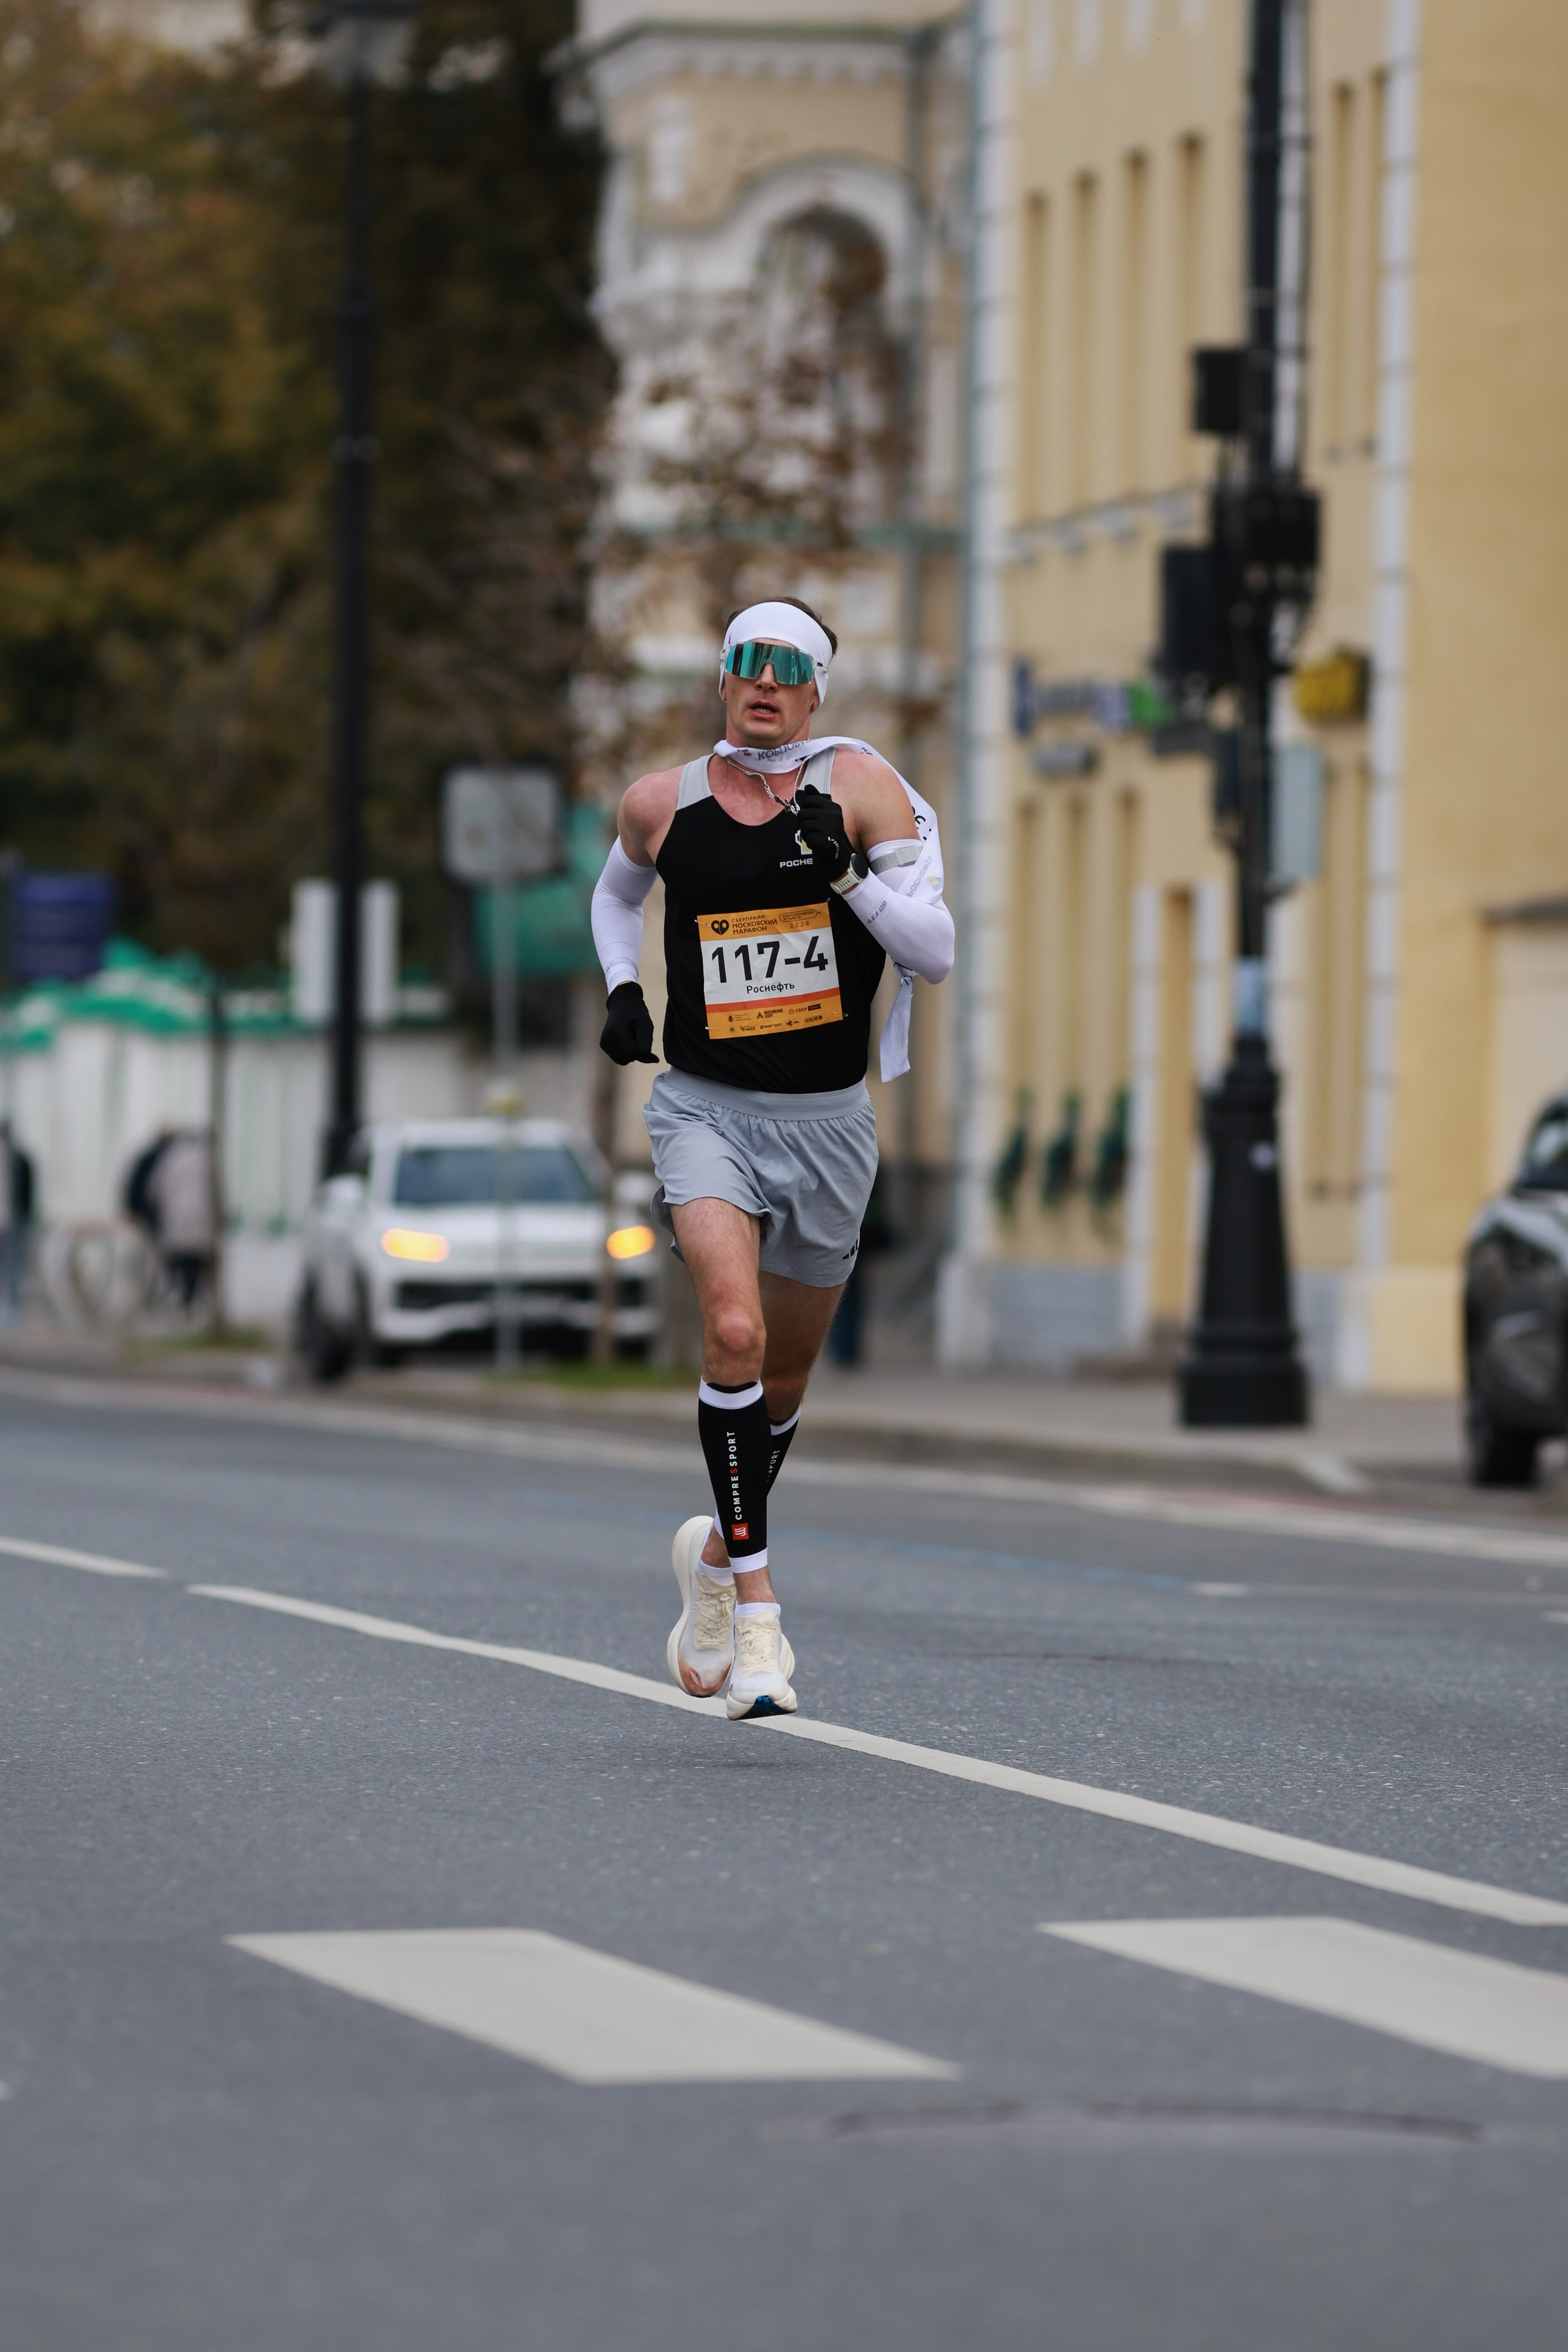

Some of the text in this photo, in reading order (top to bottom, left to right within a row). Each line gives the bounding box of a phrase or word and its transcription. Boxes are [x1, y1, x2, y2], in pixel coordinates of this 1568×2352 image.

[780, 858, 813, 869] РОСНЕ
[731, 914, 766, 923] СБЕРПРАЙМ
[867, 911, 879, 924] FIT
[732, 919, 777, 929] МОСКОВСКИЙ
[733, 925, 767, 935] МАРАФОН
[712, 935, 828, 984] 117-4
[746, 982, 795, 994] Роснефть
[726, 1431, 742, 1520] COMPRESSPORT
